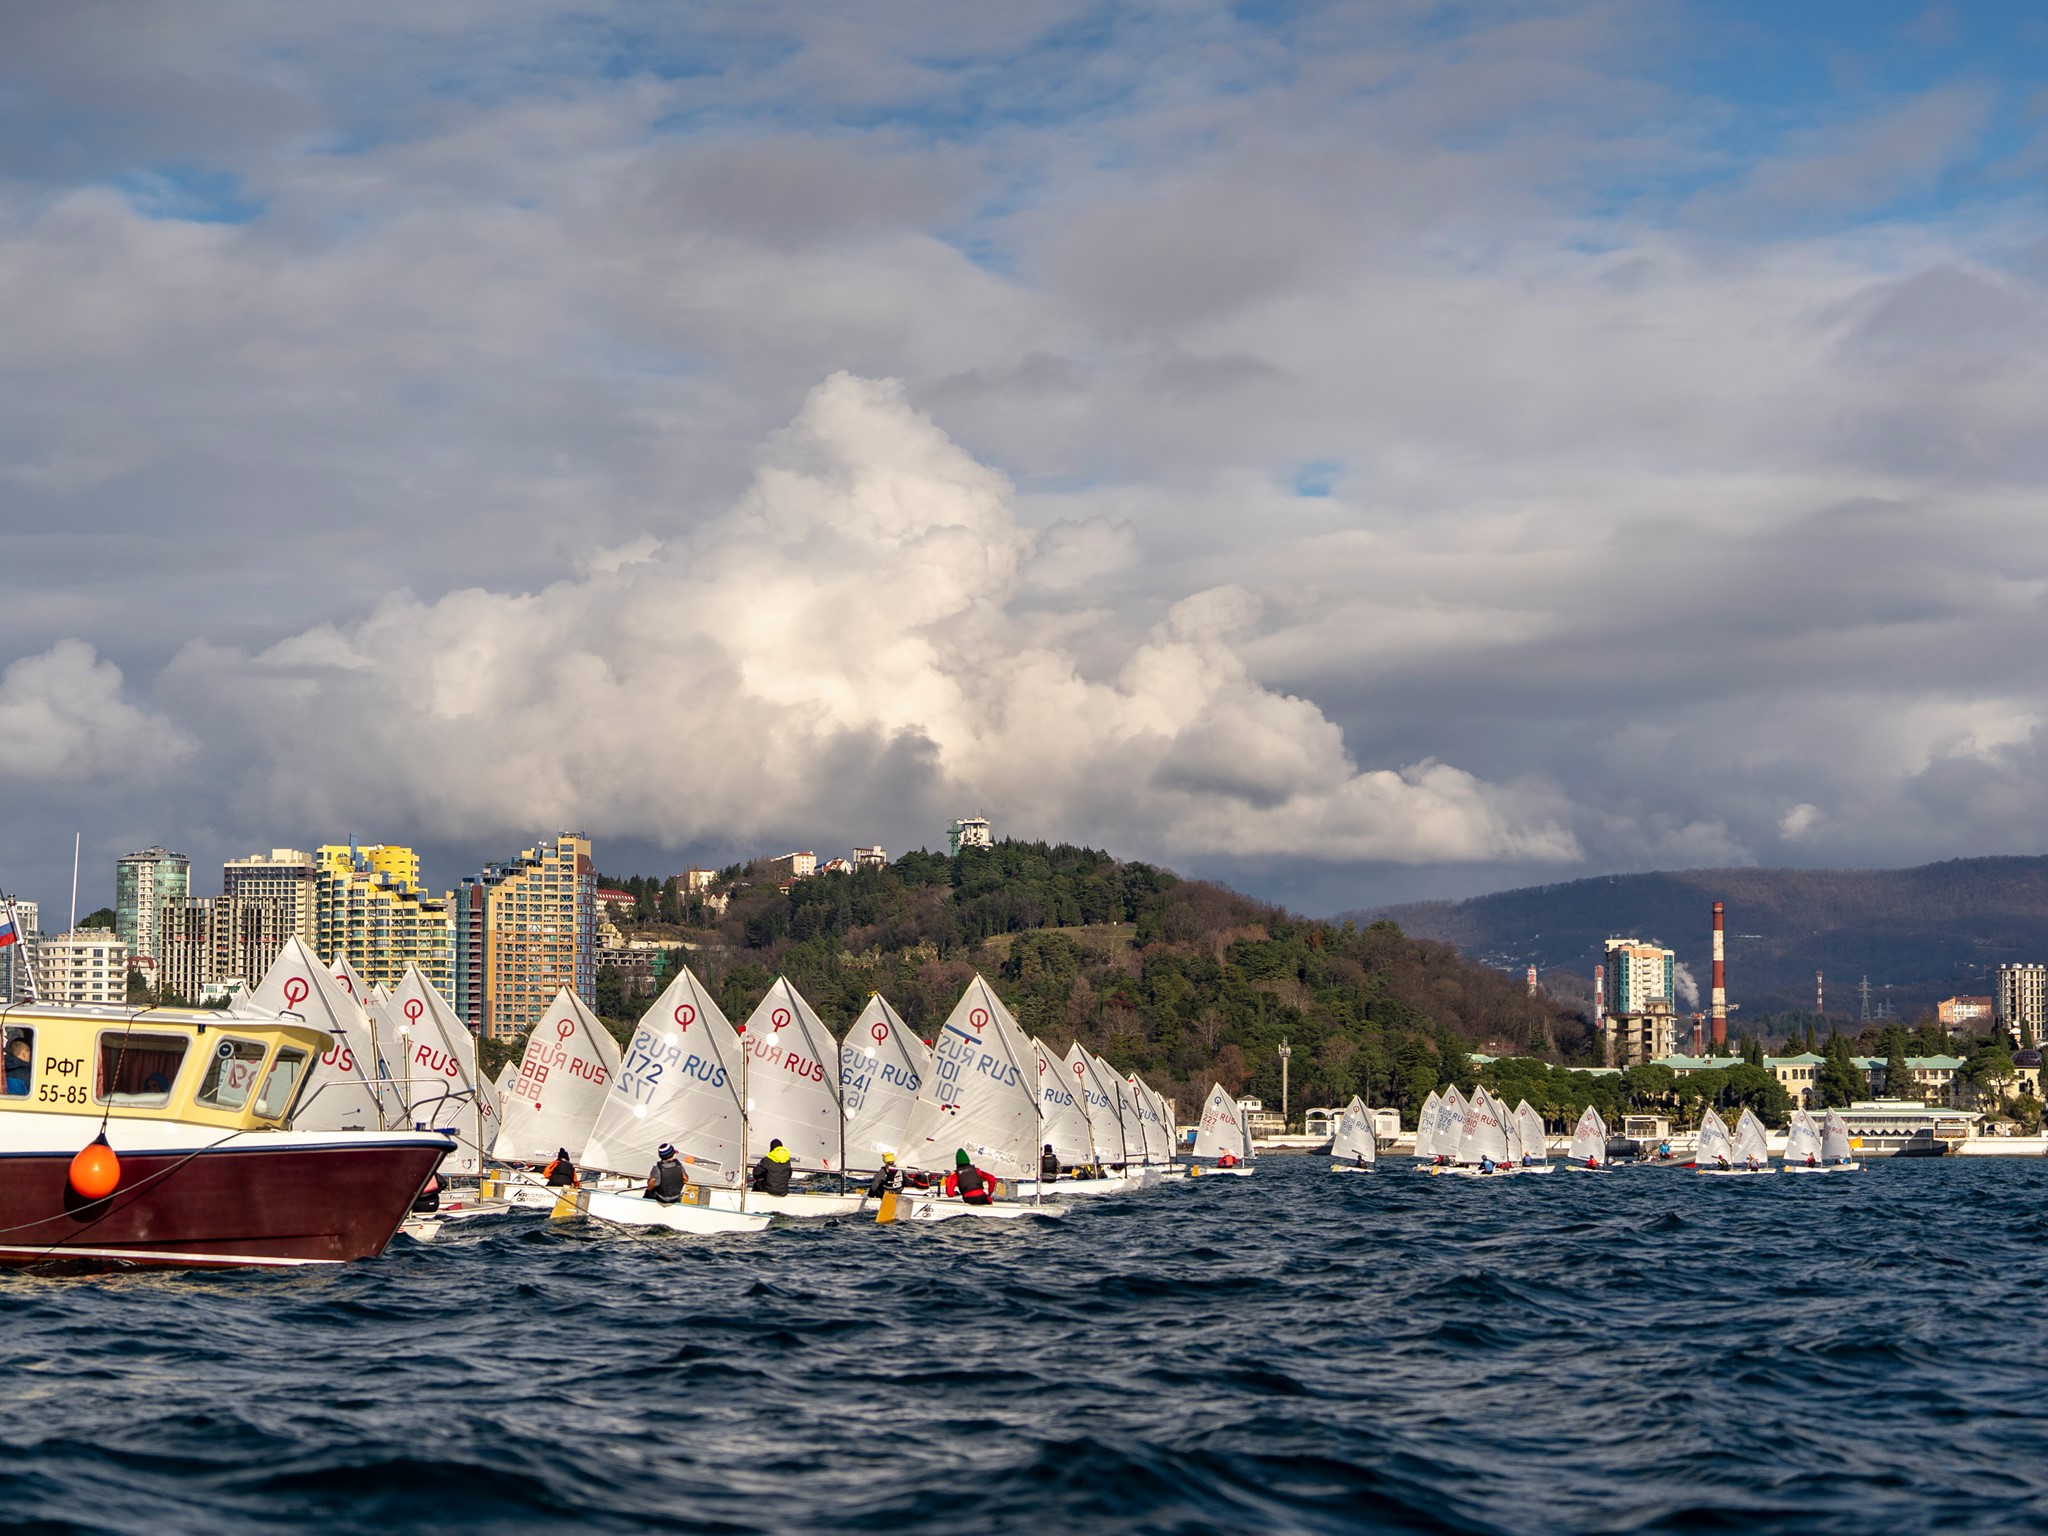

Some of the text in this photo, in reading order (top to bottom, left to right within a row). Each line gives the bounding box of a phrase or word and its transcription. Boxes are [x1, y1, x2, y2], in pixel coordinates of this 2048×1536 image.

[45, 1057, 85, 1078] РФГ
[321, 1045, 353, 1072] US
[415, 1045, 458, 1077] RUS
[569, 1057, 607, 1085] RUS
[626, 1050, 663, 1084] 172
[682, 1054, 727, 1087] RUS
[784, 1052, 825, 1082] RUS
[977, 1054, 1020, 1086] RUS
[880, 1063, 919, 1091] RUS
[39, 1084, 87, 1104] 55-85
[1044, 1088, 1072, 1106] RUS
[1203, 1114, 1217, 1125] 227
[1220, 1113, 1236, 1126] RUS
[1355, 1121, 1371, 1133] RUS
[1481, 1115, 1498, 1127] RUS
